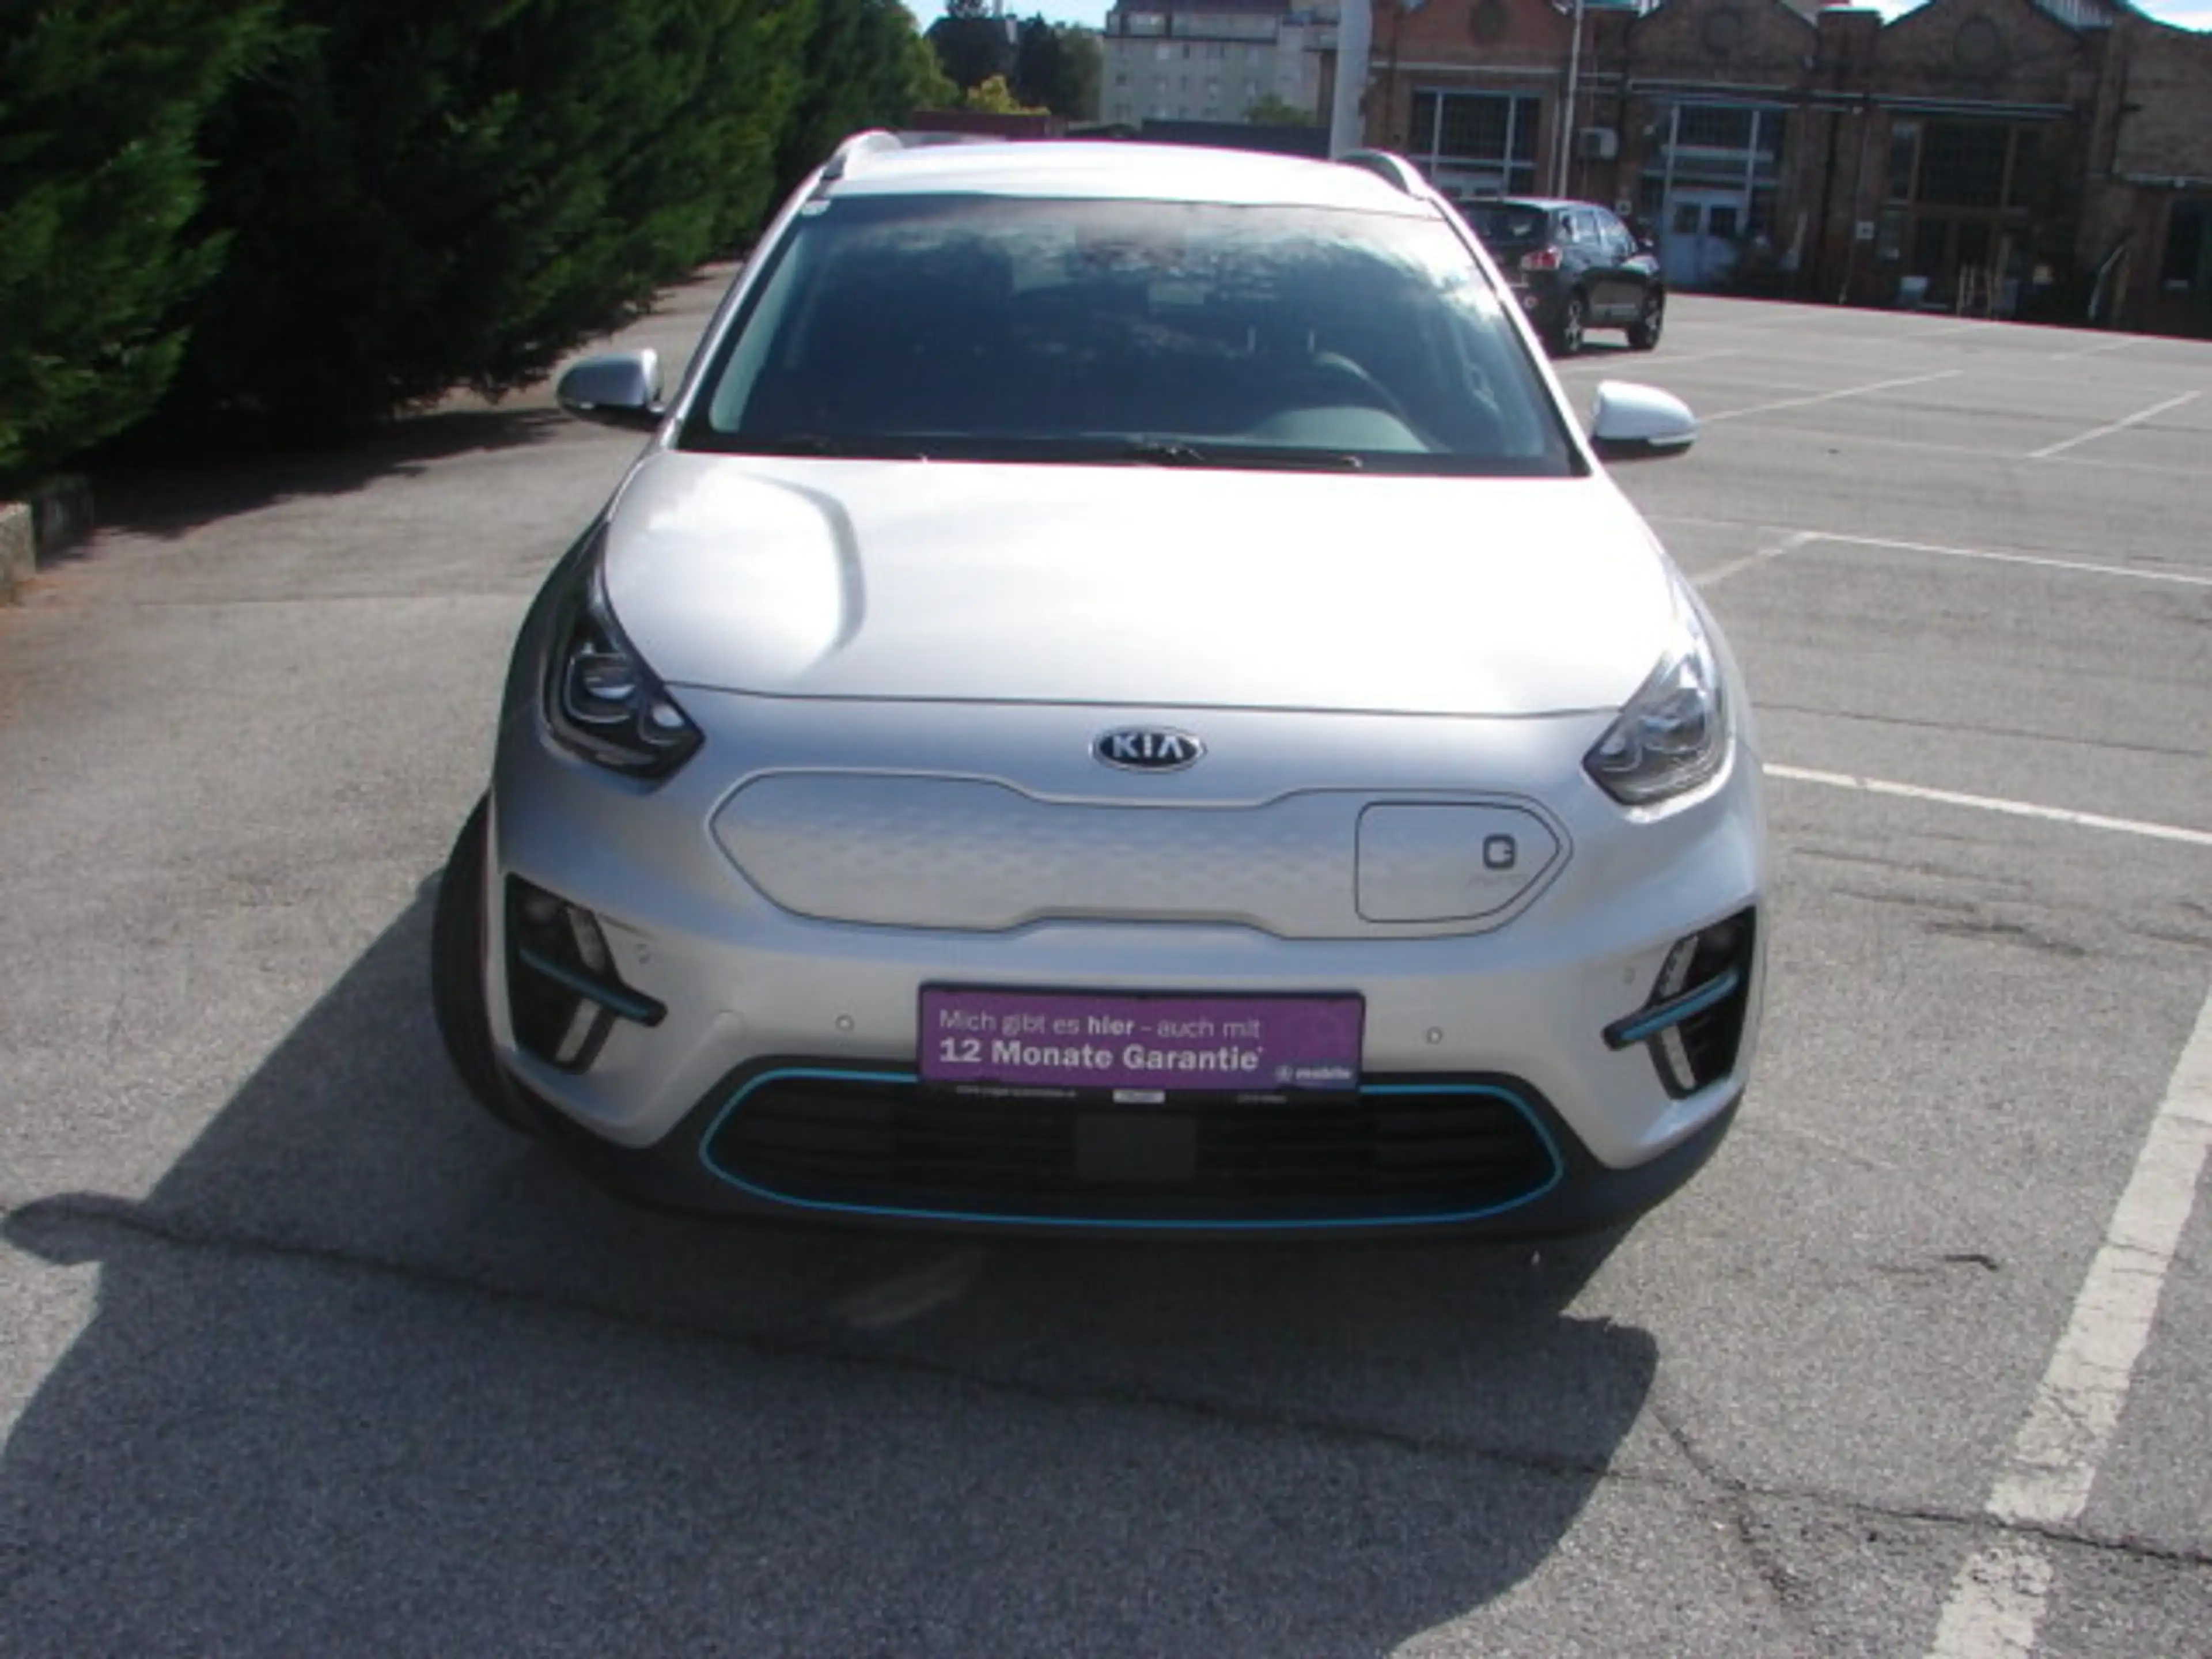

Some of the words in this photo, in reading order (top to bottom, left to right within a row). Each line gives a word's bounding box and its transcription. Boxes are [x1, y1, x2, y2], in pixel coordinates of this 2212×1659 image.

[1112, 734, 1183, 758] KIA
[940, 1009, 996, 1031] Mich
[1001, 1013, 1046, 1037] gibt
[1053, 1017, 1080, 1035] es
[1088, 1014, 1135, 1037] hier
[1157, 1017, 1215, 1038] auch
[1223, 1018, 1260, 1040] mit
[940, 1037, 982, 1063] 12
[991, 1039, 1114, 1069] Monate
